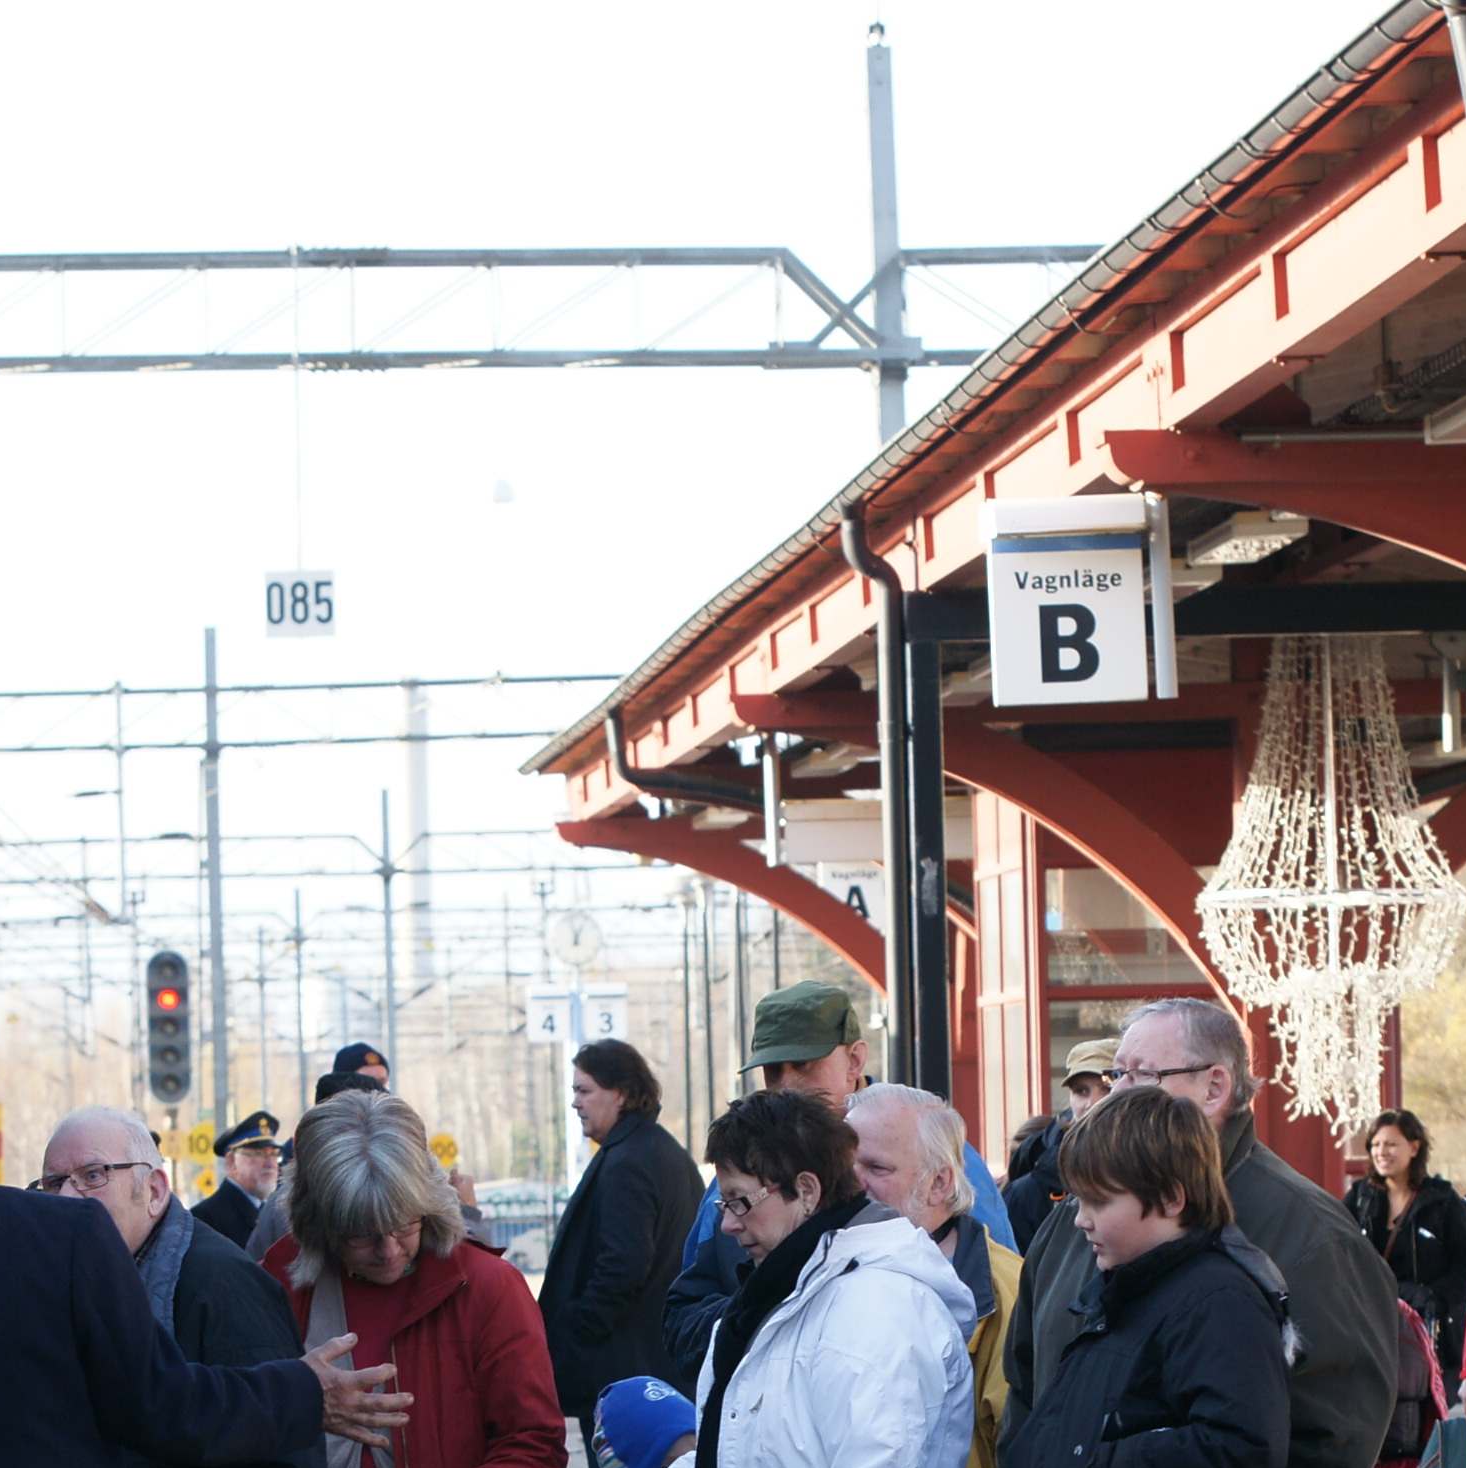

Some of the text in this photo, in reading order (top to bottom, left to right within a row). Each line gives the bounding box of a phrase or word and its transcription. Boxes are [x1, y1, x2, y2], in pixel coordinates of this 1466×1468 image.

[1014, 569, 1123, 593] Vagnläge
[267, 581, 333, 624] 085
[1039, 603, 1100, 683] B
[846, 885, 870, 918] A
[542, 1014, 555, 1034] 4
[598, 1012, 613, 1033] 3
